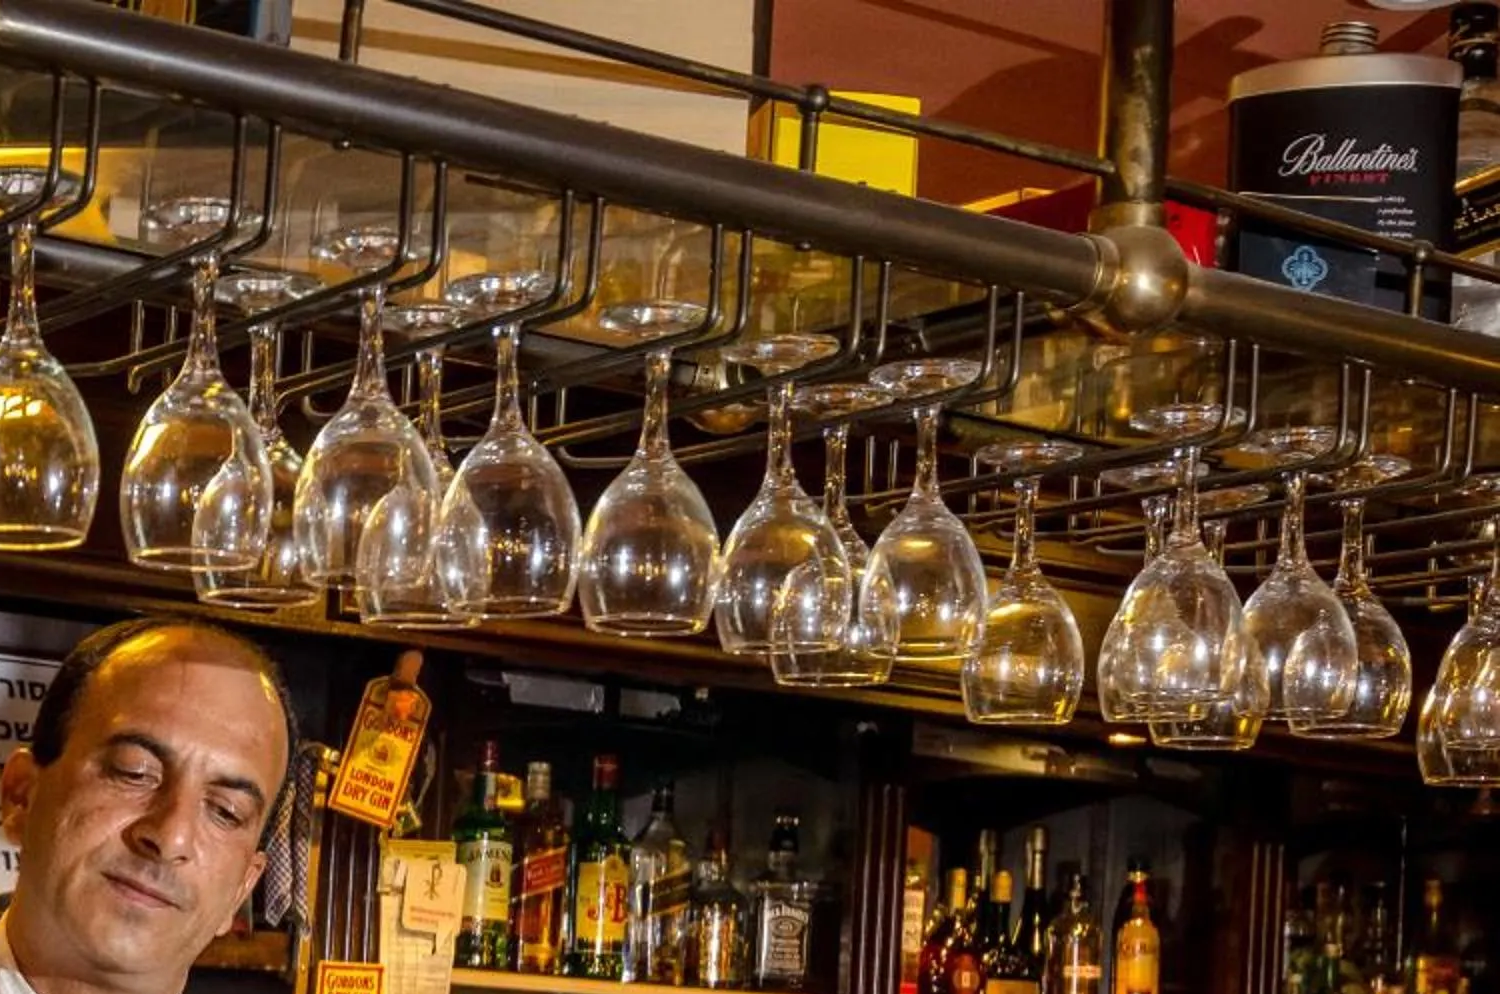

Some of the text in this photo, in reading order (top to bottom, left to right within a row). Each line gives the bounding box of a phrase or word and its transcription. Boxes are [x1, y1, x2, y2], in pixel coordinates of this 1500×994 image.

[1277, 132, 1419, 177] Ballantine's
[350, 767, 395, 793] LONDON
[342, 782, 393, 810] DRY GIN
